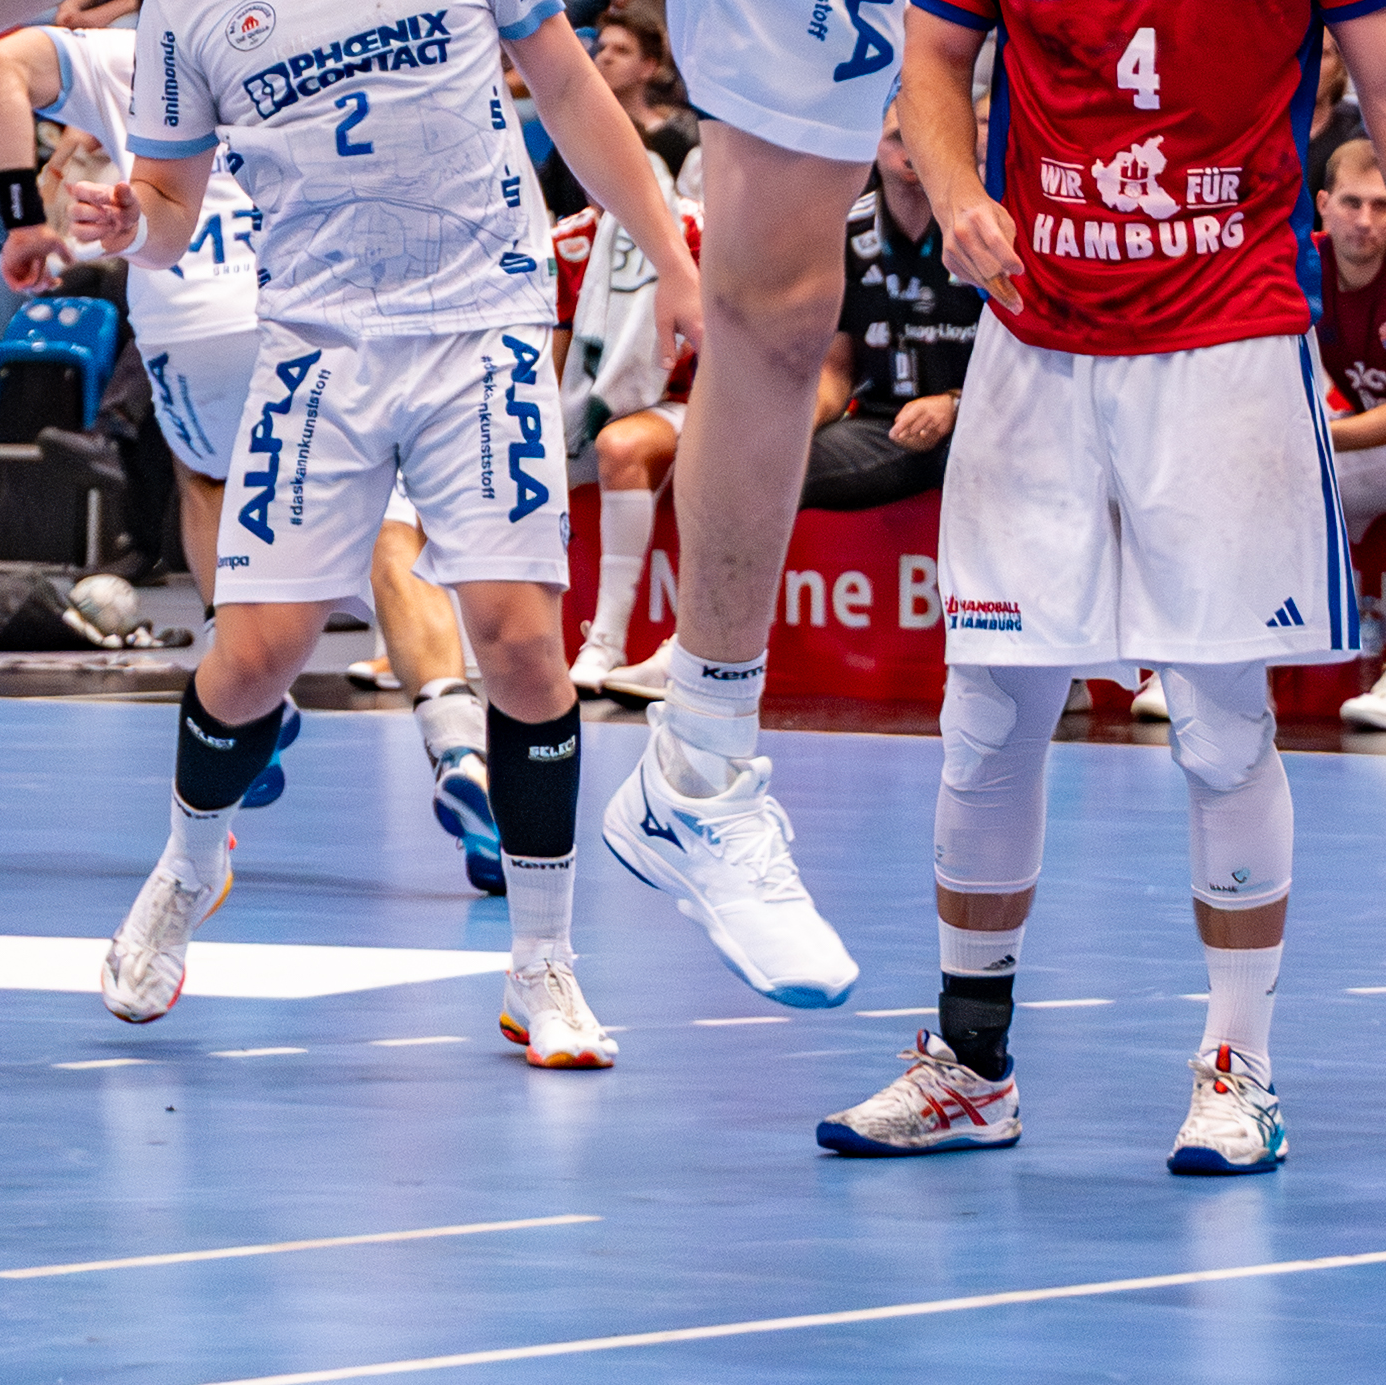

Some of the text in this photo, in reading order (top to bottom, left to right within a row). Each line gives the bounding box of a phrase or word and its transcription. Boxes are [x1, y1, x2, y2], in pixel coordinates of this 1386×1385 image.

[161, 31, 180, 127] animonda
[296, 36, 452, 97] CONTACT
[1117, 27, 1161, 111] 4
[334, 90, 375, 157] 2
[1041, 165, 1241, 204] WIR FÜR
[1032, 211, 1245, 260] HAMBURG
[213, 264, 252, 277] GROU
[217, 554, 250, 571] empa
